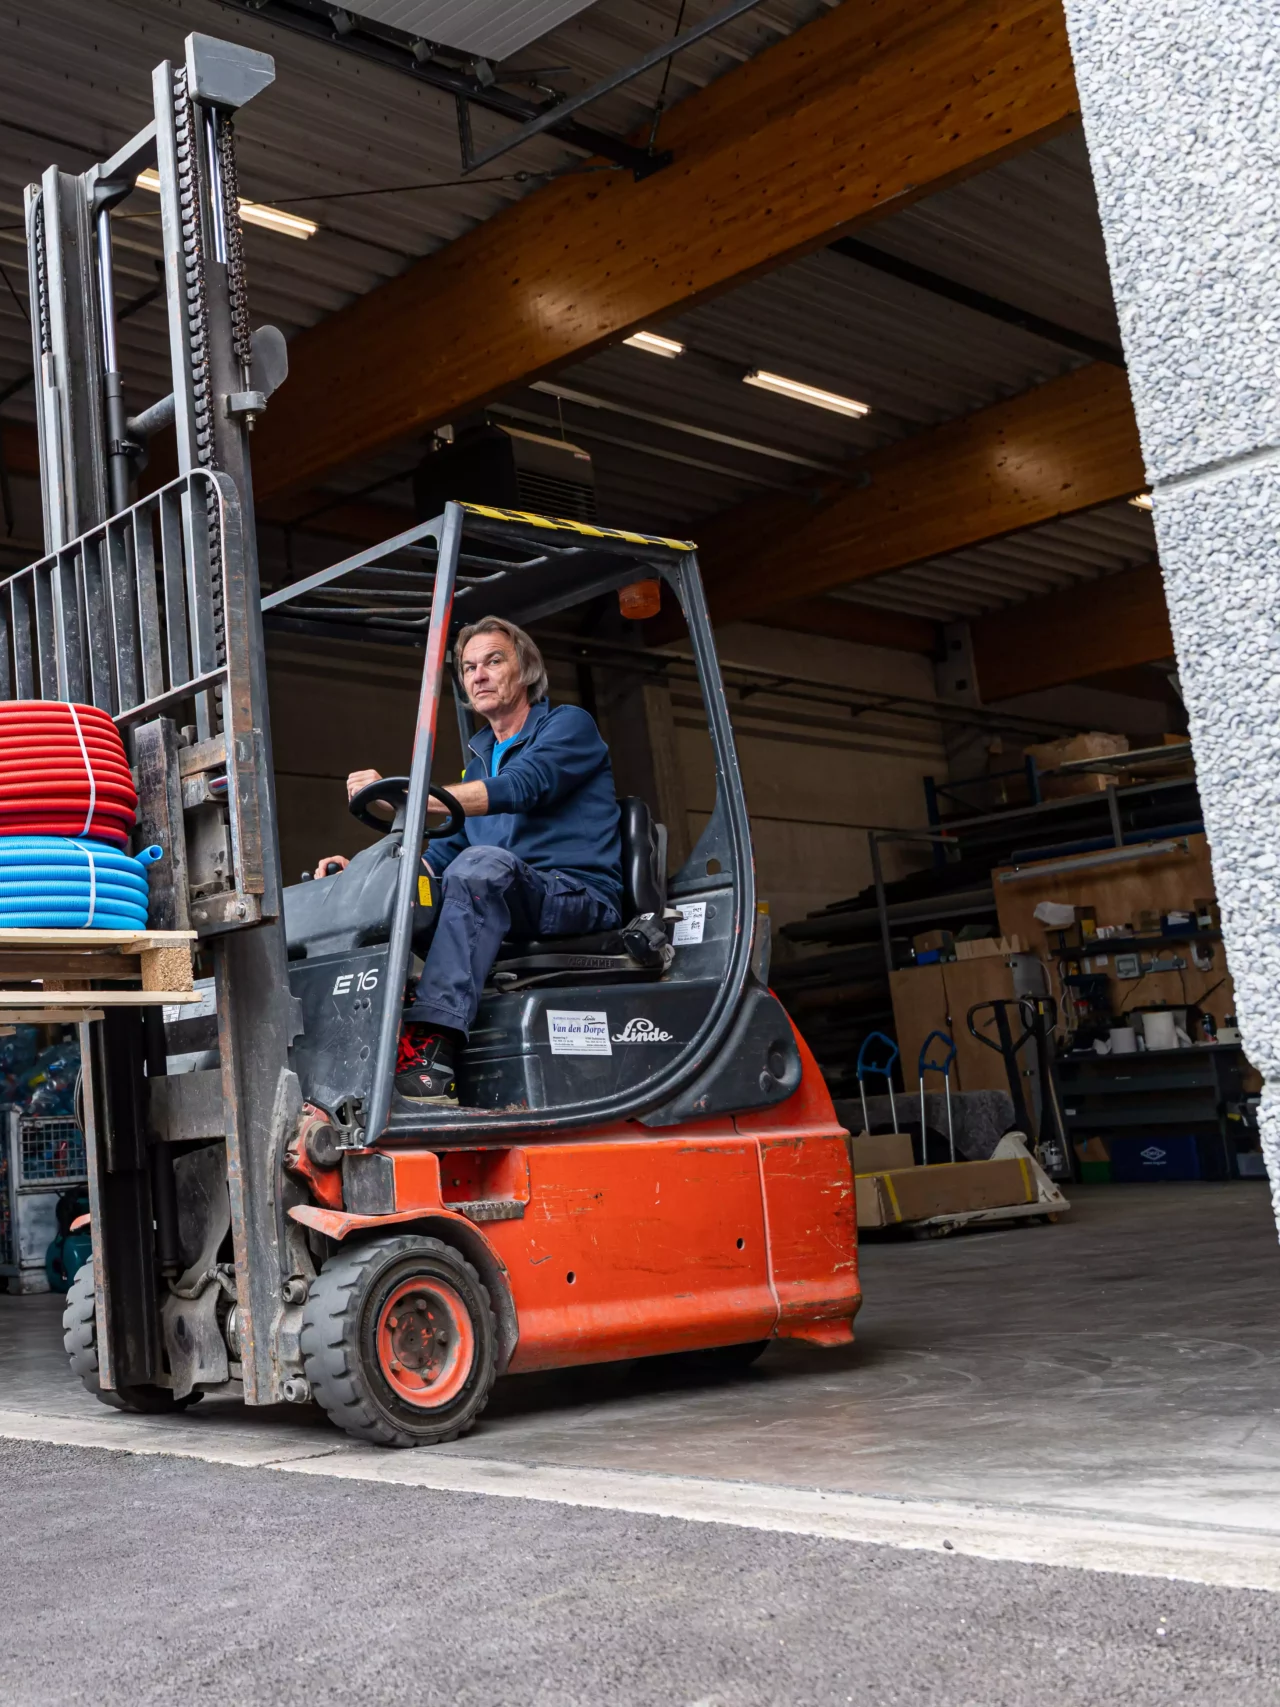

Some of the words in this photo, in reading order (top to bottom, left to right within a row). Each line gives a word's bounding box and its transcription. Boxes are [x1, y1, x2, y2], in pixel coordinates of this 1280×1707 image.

[552, 1023, 567, 1033] Van
[568, 1023, 581, 1033] den
[583, 1024, 606, 1036] Dorpe
[611, 1017, 674, 1042] Linde
